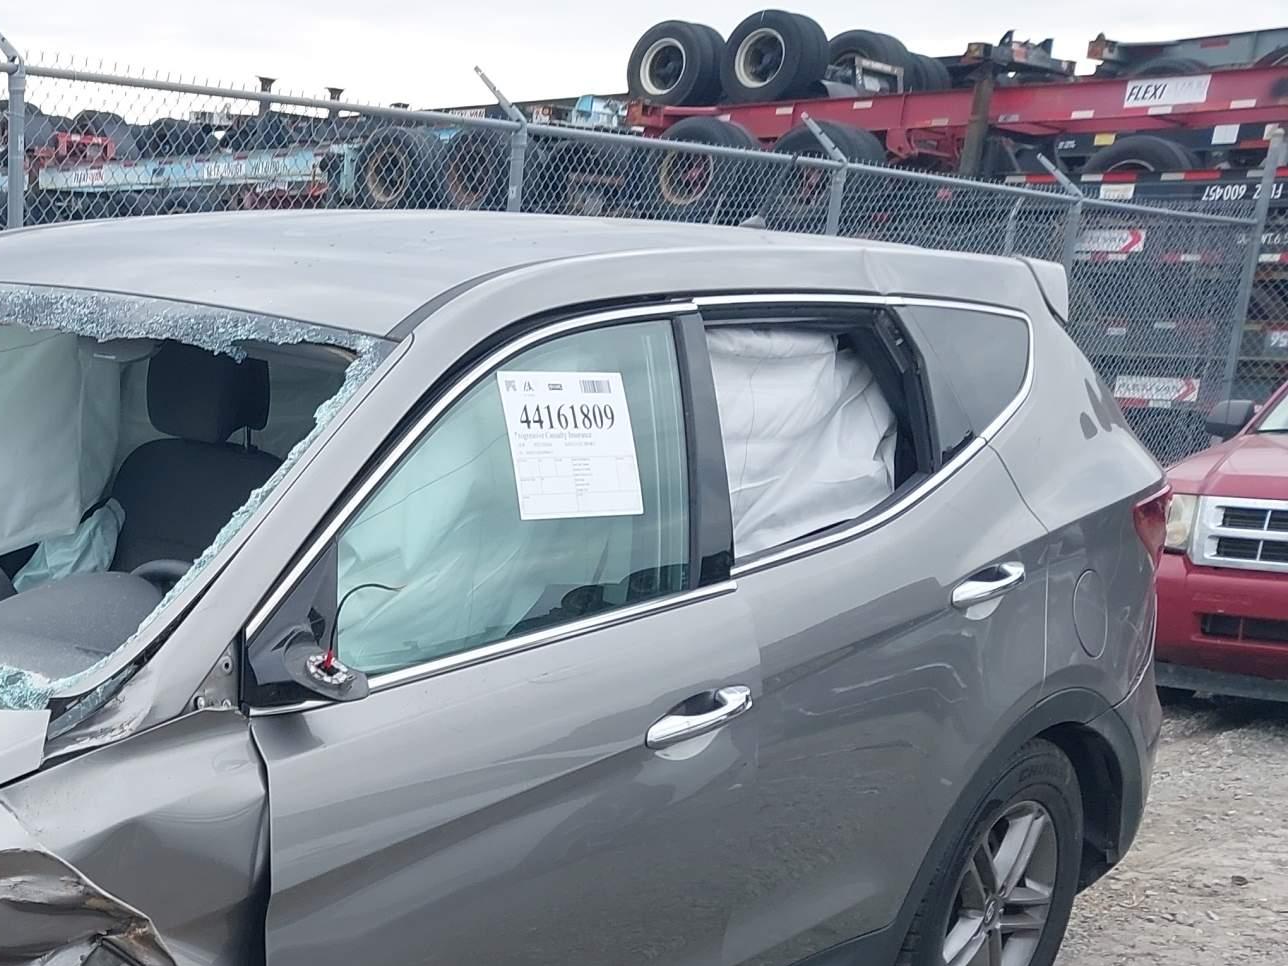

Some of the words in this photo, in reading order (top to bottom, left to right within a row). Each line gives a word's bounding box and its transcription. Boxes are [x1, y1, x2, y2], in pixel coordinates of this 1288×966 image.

[1126, 83, 1168, 102] FLEXI
[1202, 183, 1248, 201] 600457
[1252, 183, 1284, 199] FLZ
[520, 403, 614, 430] 44161809
